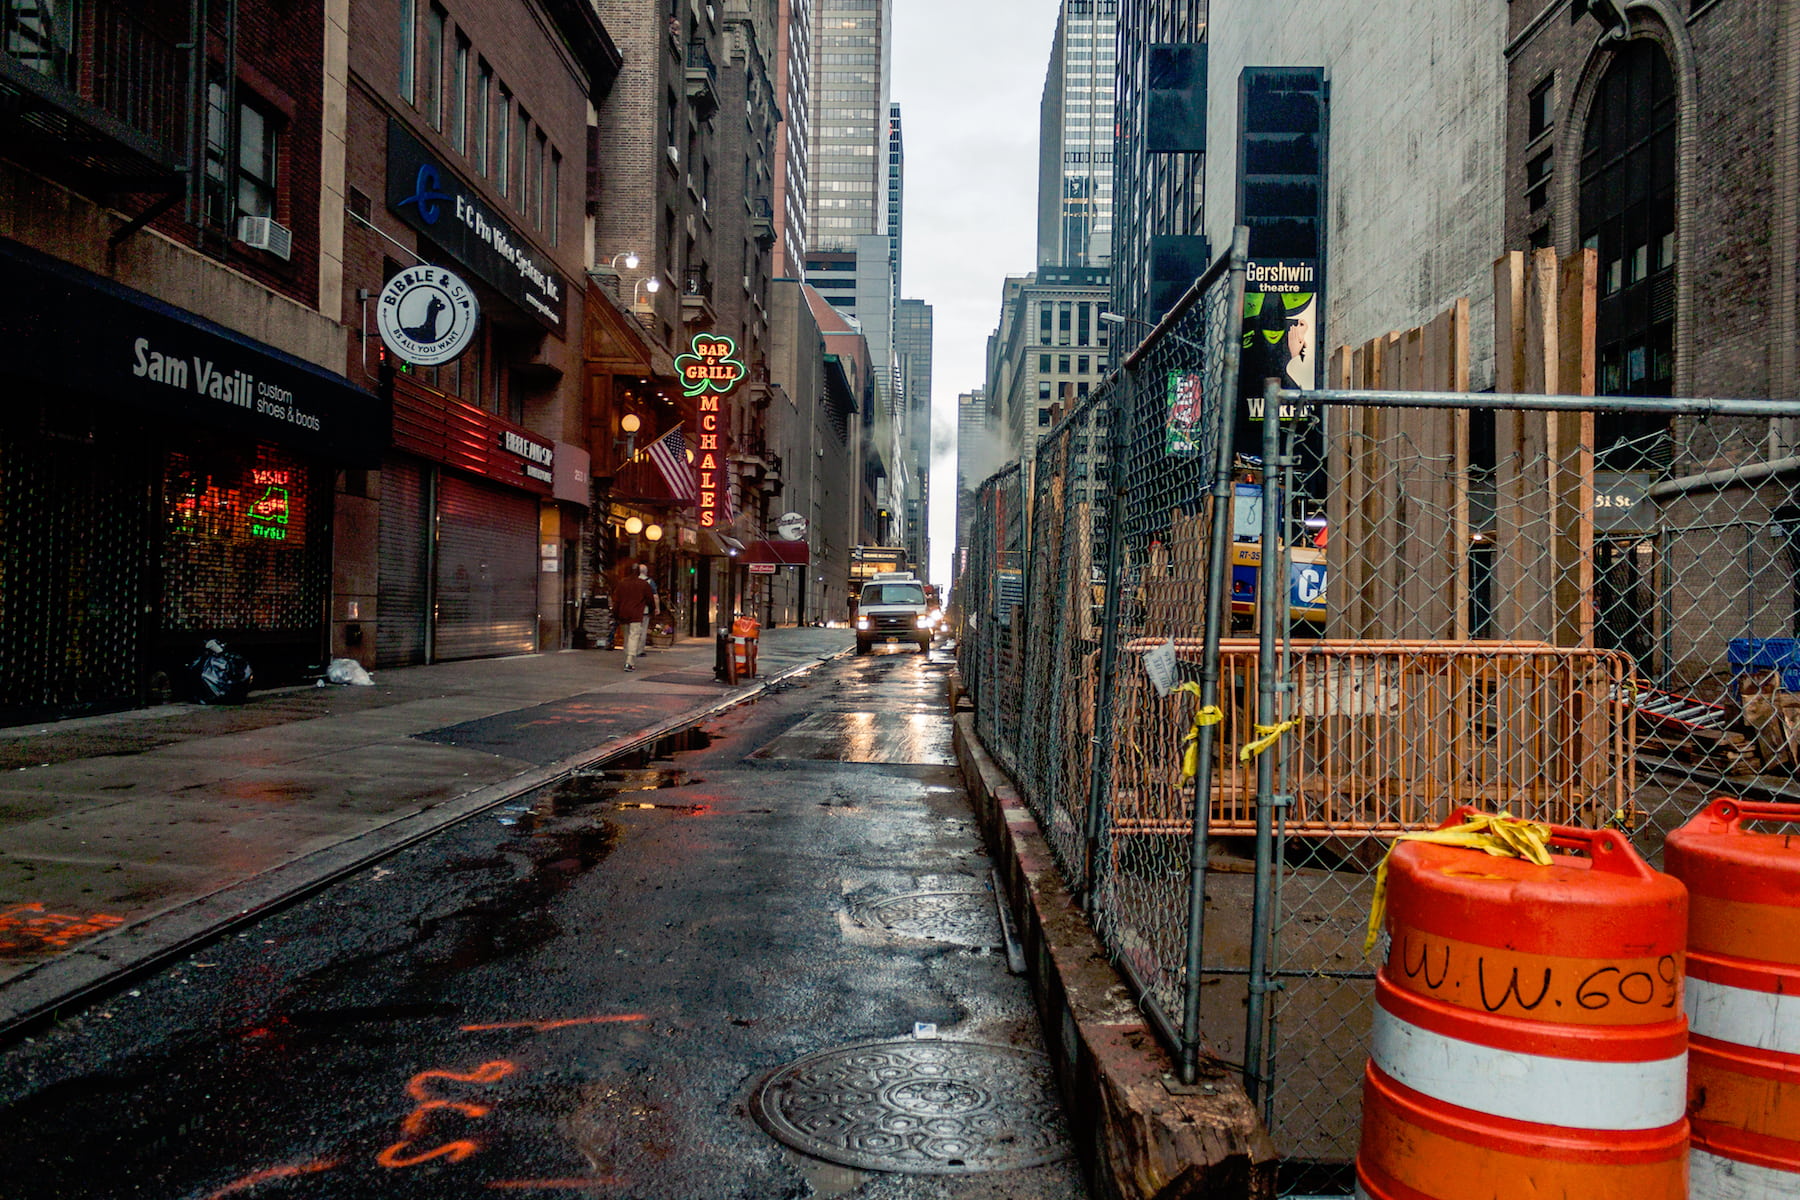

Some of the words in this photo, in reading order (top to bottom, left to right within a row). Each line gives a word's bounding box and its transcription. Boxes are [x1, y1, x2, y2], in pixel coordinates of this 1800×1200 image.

[476, 212, 491, 244] Pro
[492, 227, 515, 263] Video
[1246, 261, 1314, 282] Gershwin
[383, 270, 434, 306] BIBBLE
[439, 274, 449, 288] &
[451, 286, 470, 309] SIP
[1259, 283, 1300, 292] theatre
[401, 341, 416, 351] ALL
[438, 330, 460, 350] WANT
[698, 343, 729, 356] BAR
[706, 356, 716, 366] &
[133, 338, 188, 389] Sam
[193, 356, 254, 409] Vasili
[685, 365, 737, 380] GRILL
[258, 382, 293, 405] custom
[257, 397, 286, 420] shoes
[287, 406, 294, 423] &
[295, 411, 321, 431] boots
[699, 394, 719, 527] MCHALES
[1595, 494, 1612, 508] 51
[1615, 495, 1635, 508] St.
